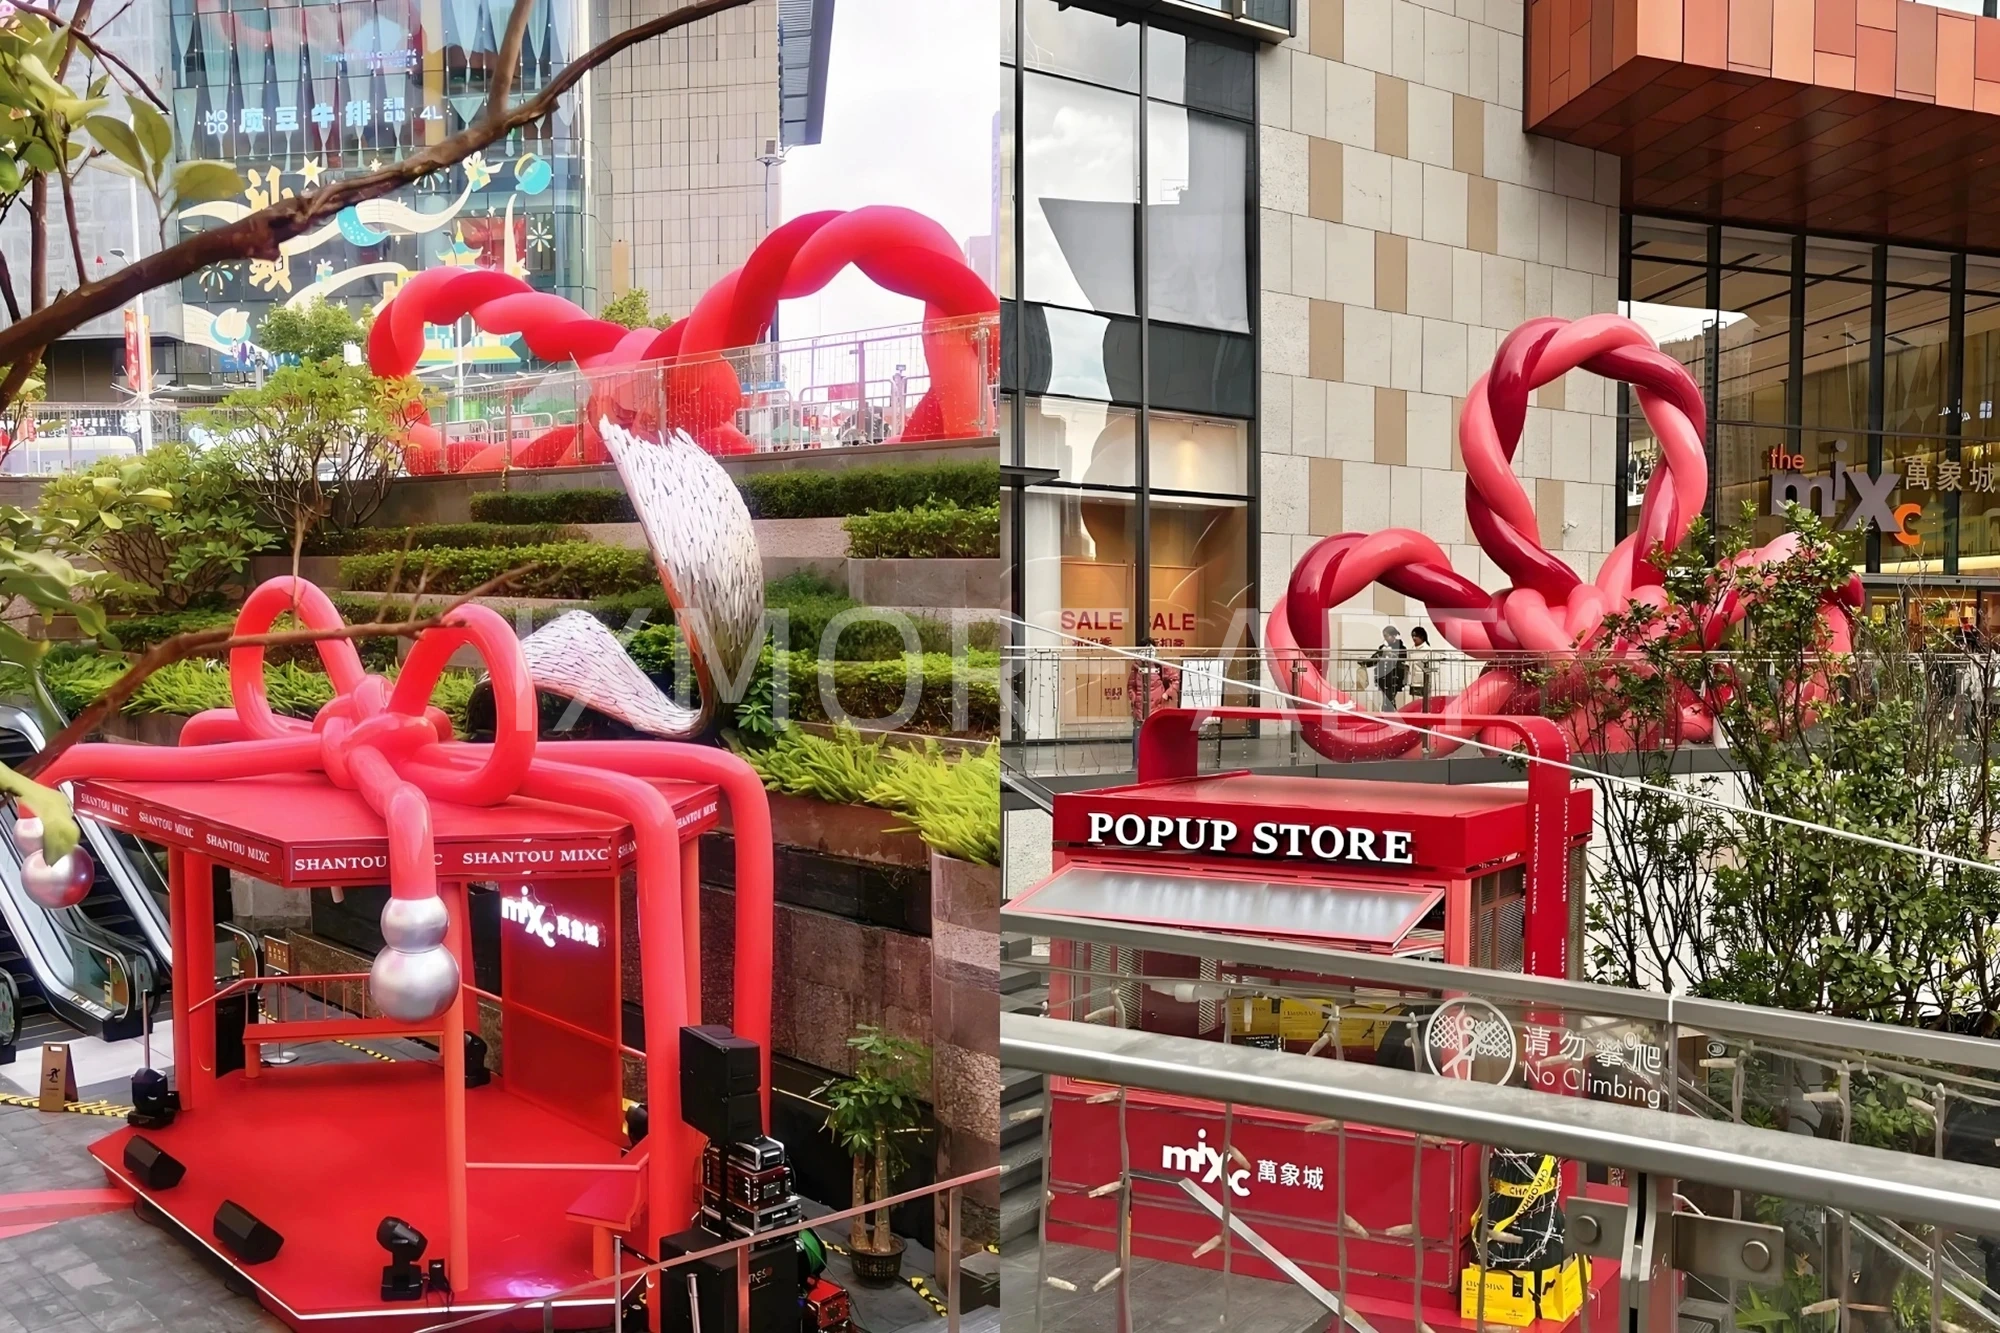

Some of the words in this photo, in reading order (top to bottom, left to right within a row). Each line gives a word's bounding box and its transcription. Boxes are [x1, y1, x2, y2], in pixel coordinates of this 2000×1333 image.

[206, 110, 228, 121] MO
[420, 105, 443, 120] 4L
[207, 122, 229, 135] DO
[1771, 444, 1805, 470] the
[1905, 456, 1996, 493] 萬象城
[1061, 611, 1123, 630] SALE
[1149, 612, 1195, 631] ALE
[206, 833, 245, 855] SHANTOU
[247, 844, 270, 864] MIXC
[1087, 812, 1238, 851] POPUP
[1252, 822, 1414, 864] STORE
[294, 855, 387, 871] SHANTOU
[462, 850, 554, 865] SHANTOU
[560, 848, 610, 862] MIXC
[1523, 1025, 1662, 1075] 请勿攀爬
[1524, 1061, 1555, 1086] No
[1563, 1067, 1661, 1110] Climbing
[1162, 1128, 1252, 1197] mixc
[1257, 1159, 1325, 1192] 萬象城
